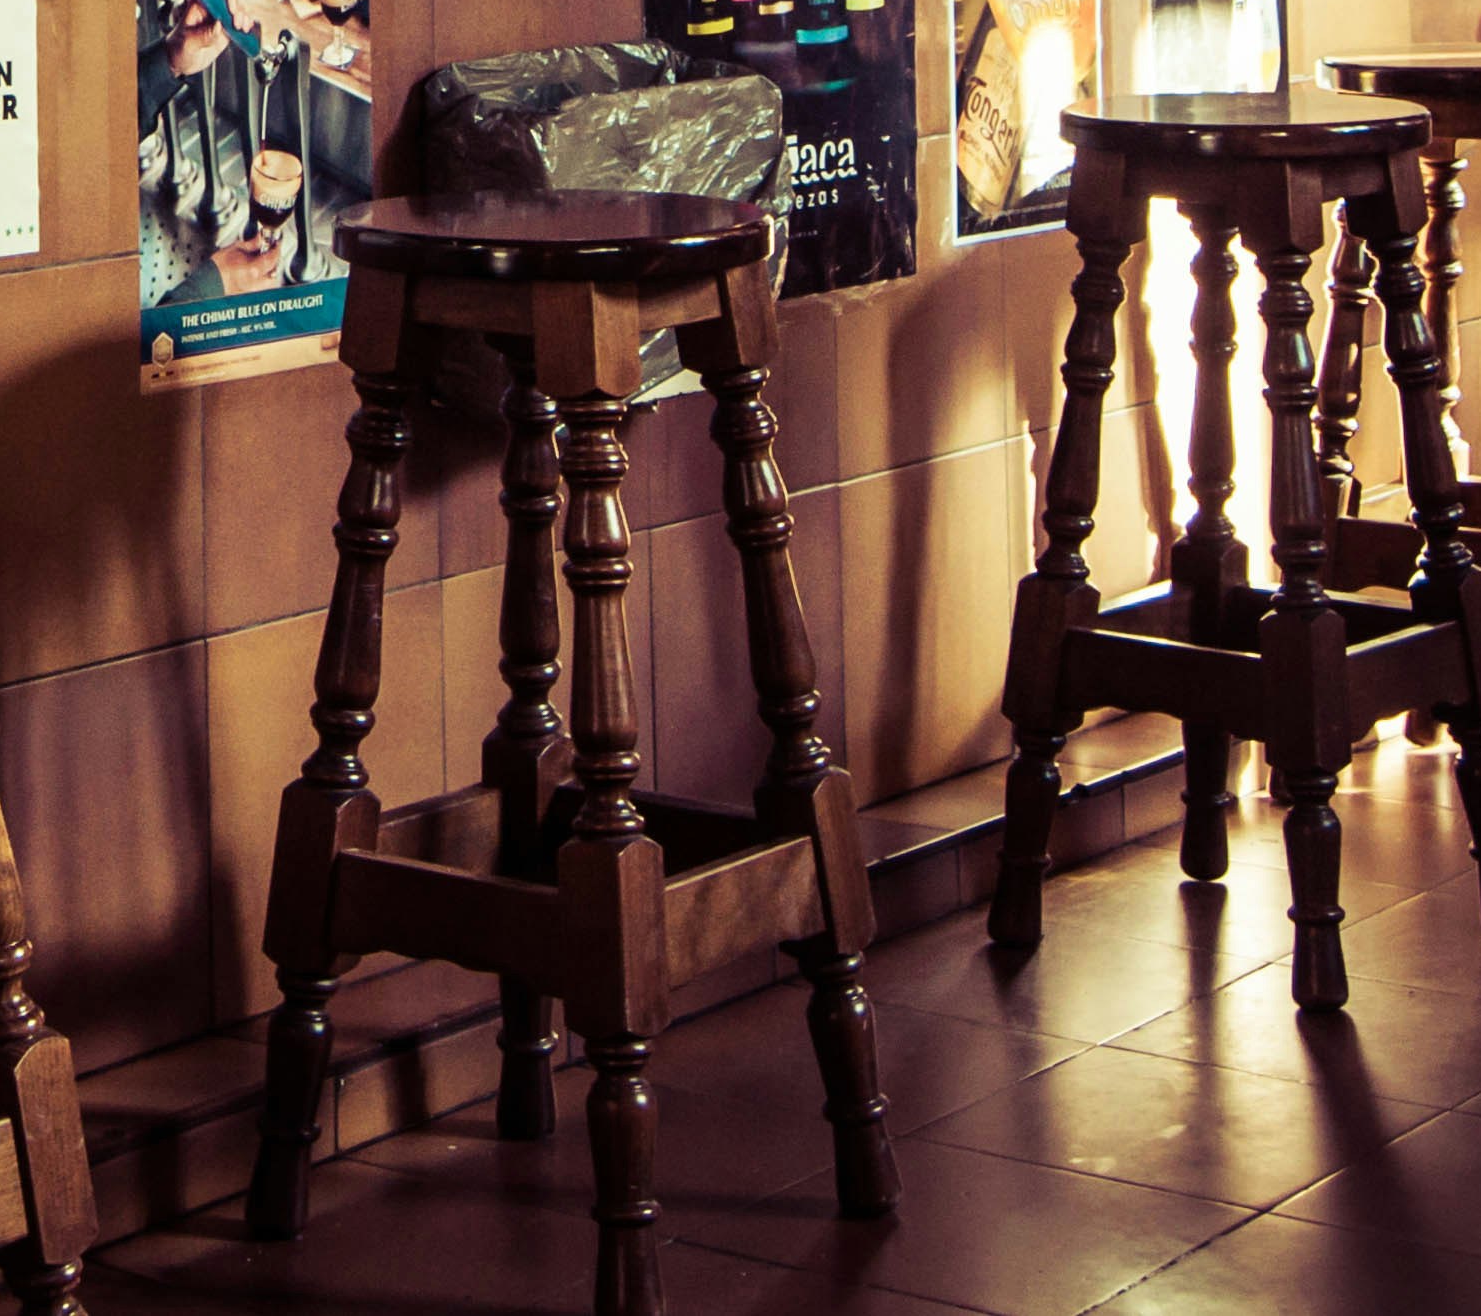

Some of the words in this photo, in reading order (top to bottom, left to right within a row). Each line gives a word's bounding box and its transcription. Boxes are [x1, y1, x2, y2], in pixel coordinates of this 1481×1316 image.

[181, 314, 199, 329] THE
[200, 308, 237, 326] CHIMAY
[238, 304, 262, 319] BLUE
[263, 301, 277, 314] ON
[278, 294, 325, 313] DRAUGHT
